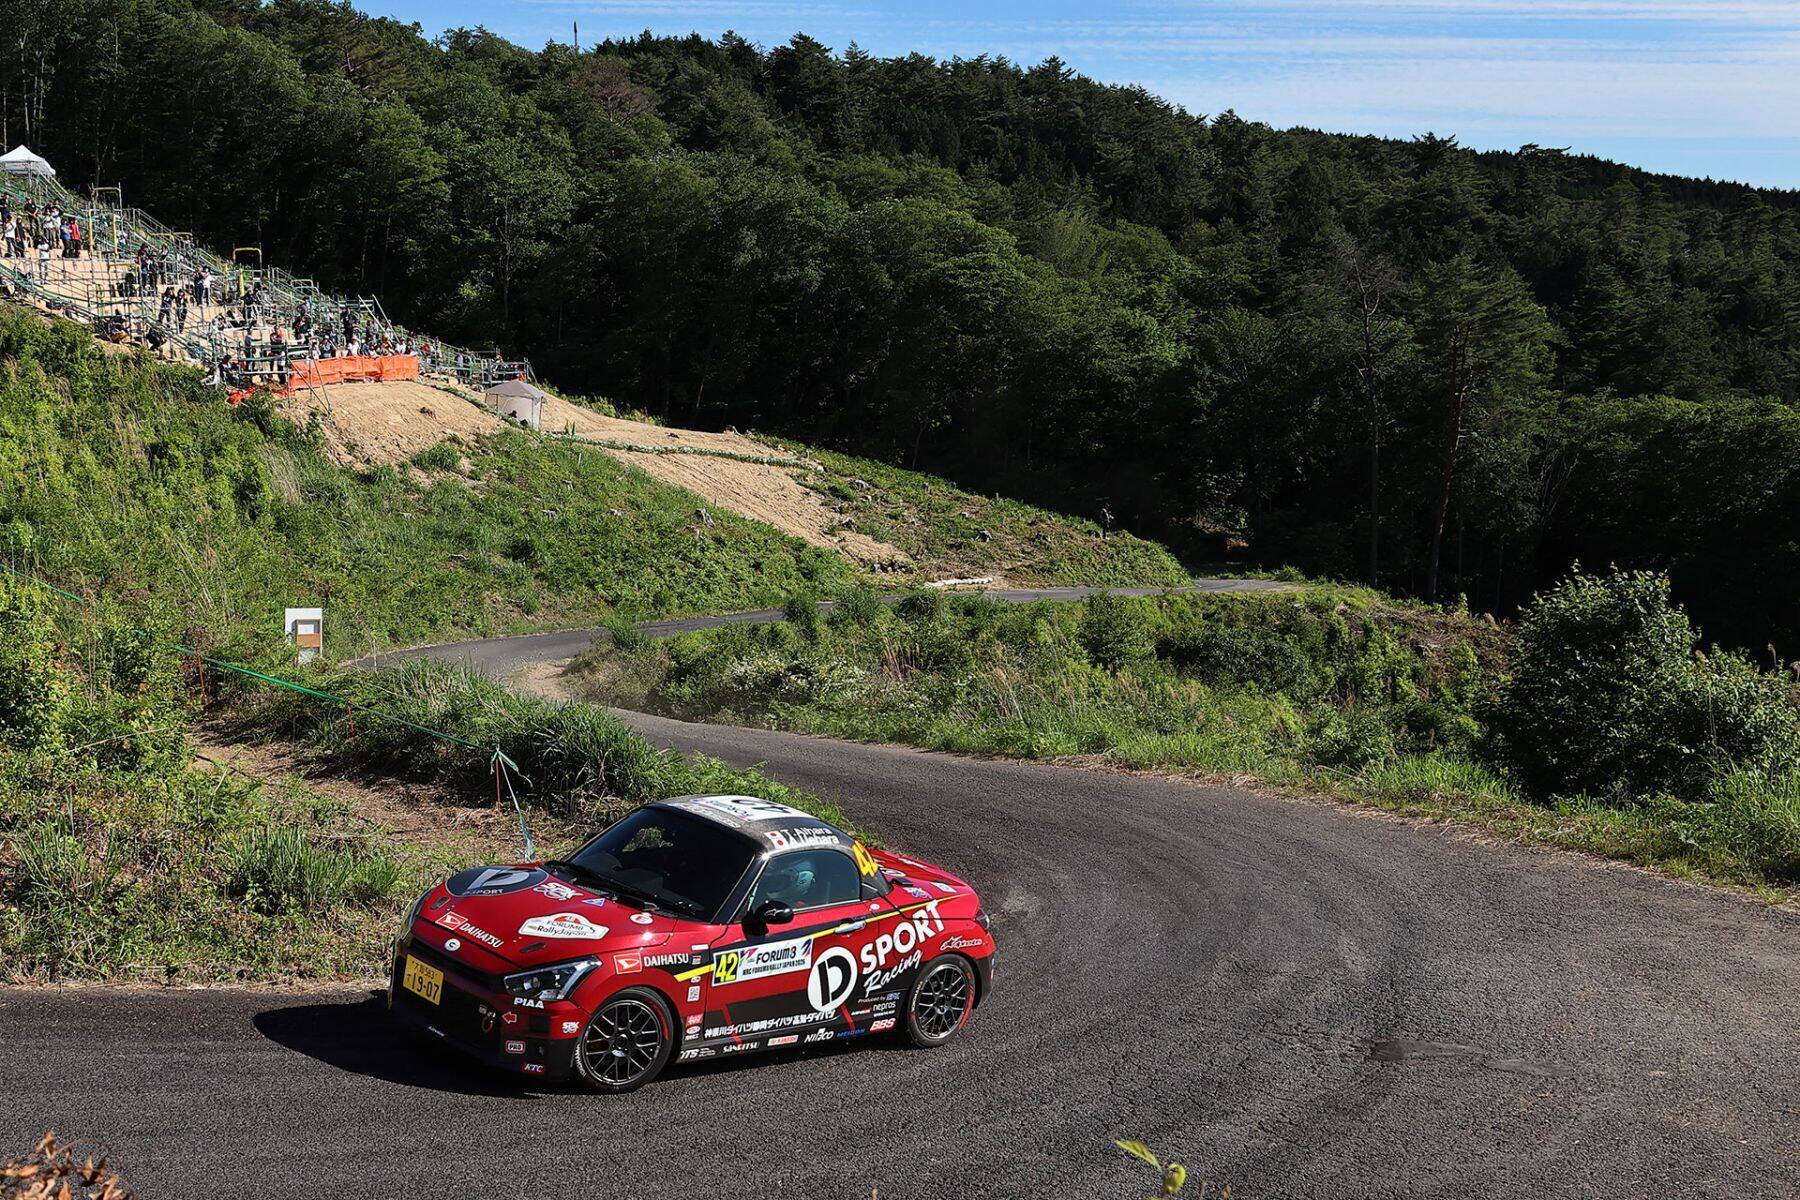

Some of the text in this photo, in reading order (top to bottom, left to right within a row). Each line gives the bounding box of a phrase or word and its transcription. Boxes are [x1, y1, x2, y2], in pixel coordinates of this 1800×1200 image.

[458, 923, 505, 949] DAIHATSU
[860, 899, 945, 975] SPORT
[643, 953, 690, 968] DAIHATSU
[715, 952, 740, 983] 42
[412, 972, 440, 1001] 19-07
[863, 950, 923, 998] Racing
[513, 997, 545, 1009] PIAA
[870, 1019, 896, 1031] BBS
[524, 1063, 544, 1073] KTC
